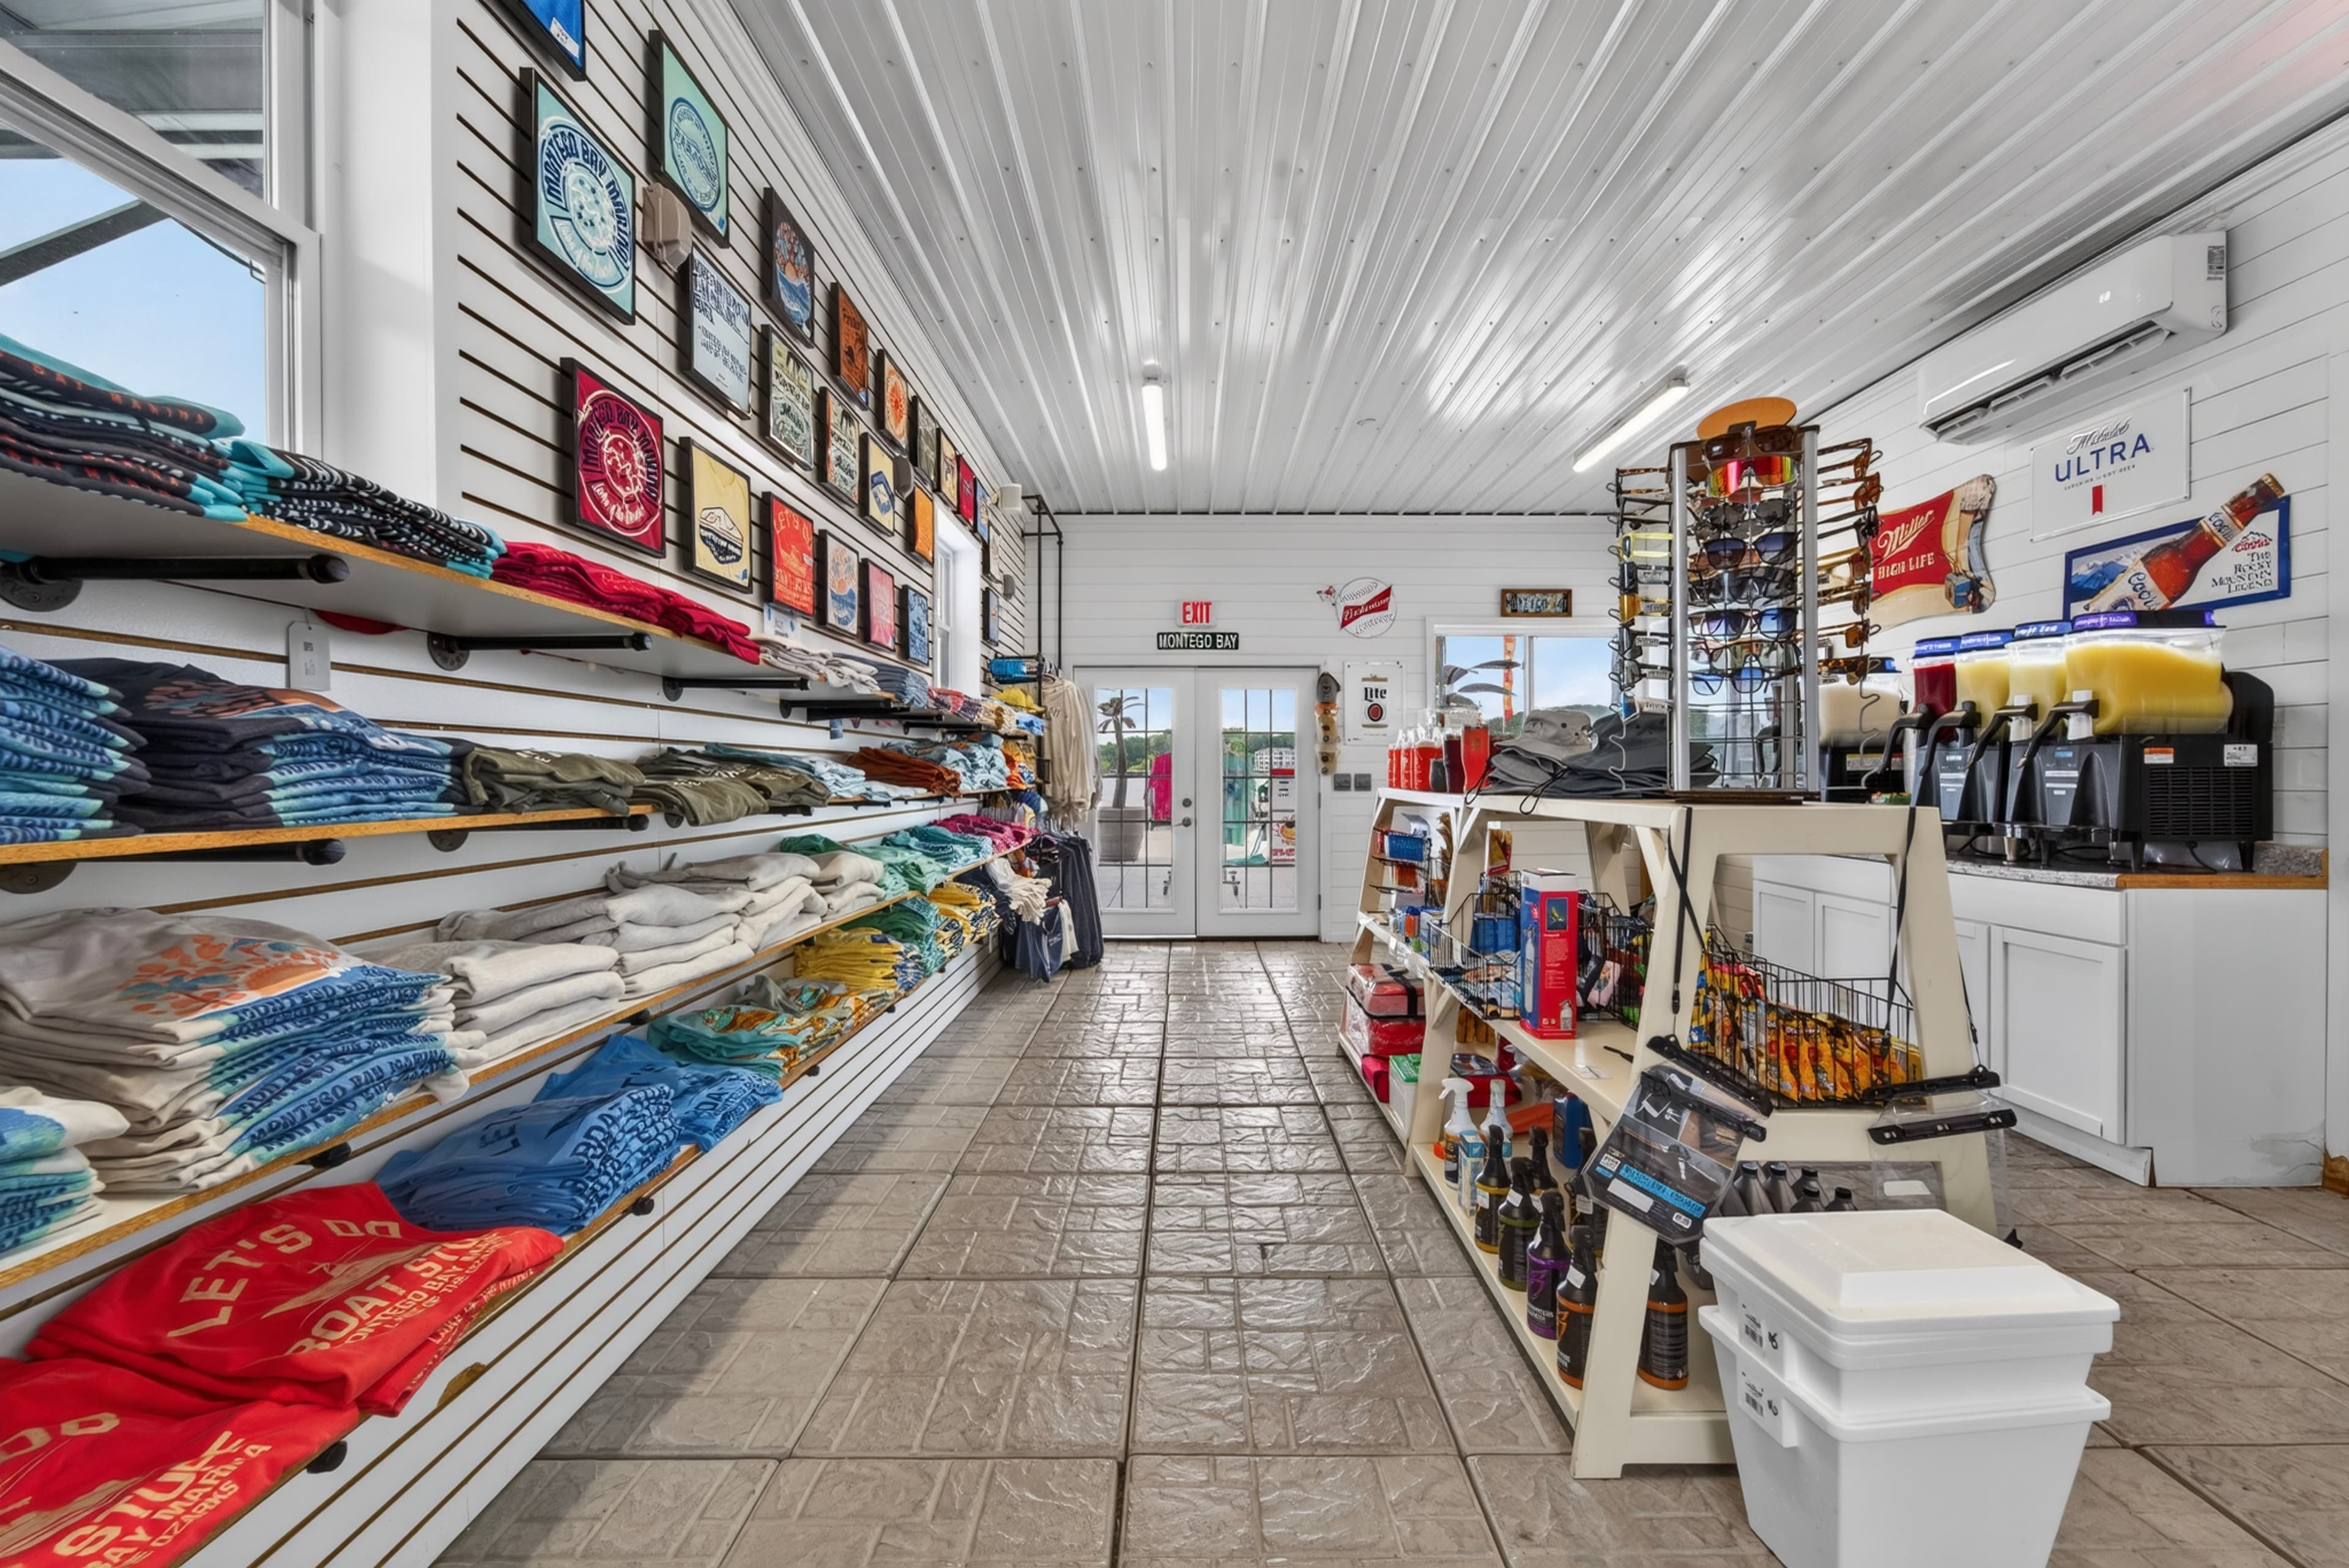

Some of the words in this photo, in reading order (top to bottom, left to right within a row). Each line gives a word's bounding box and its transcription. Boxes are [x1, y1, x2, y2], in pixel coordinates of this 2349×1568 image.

[2055, 433, 2151, 483] ULTRA
[1877, 510, 1935, 559] Miller
[1909, 552, 1935, 571] LIFE
[1182, 601, 1212, 623] EXIT
[1159, 634, 1212, 648] MONTEGO
[1216, 634, 1237, 648] BAY
[166, 1223, 313, 1337] LET'S
[321, 1219, 401, 1238] DO
[284, 1274, 406, 1356] BOAT
[344, 1289, 430, 1344] ONTEGO
[421, 1265, 464, 1291] BAY
[150, 1479, 240, 1548] OZARKS
